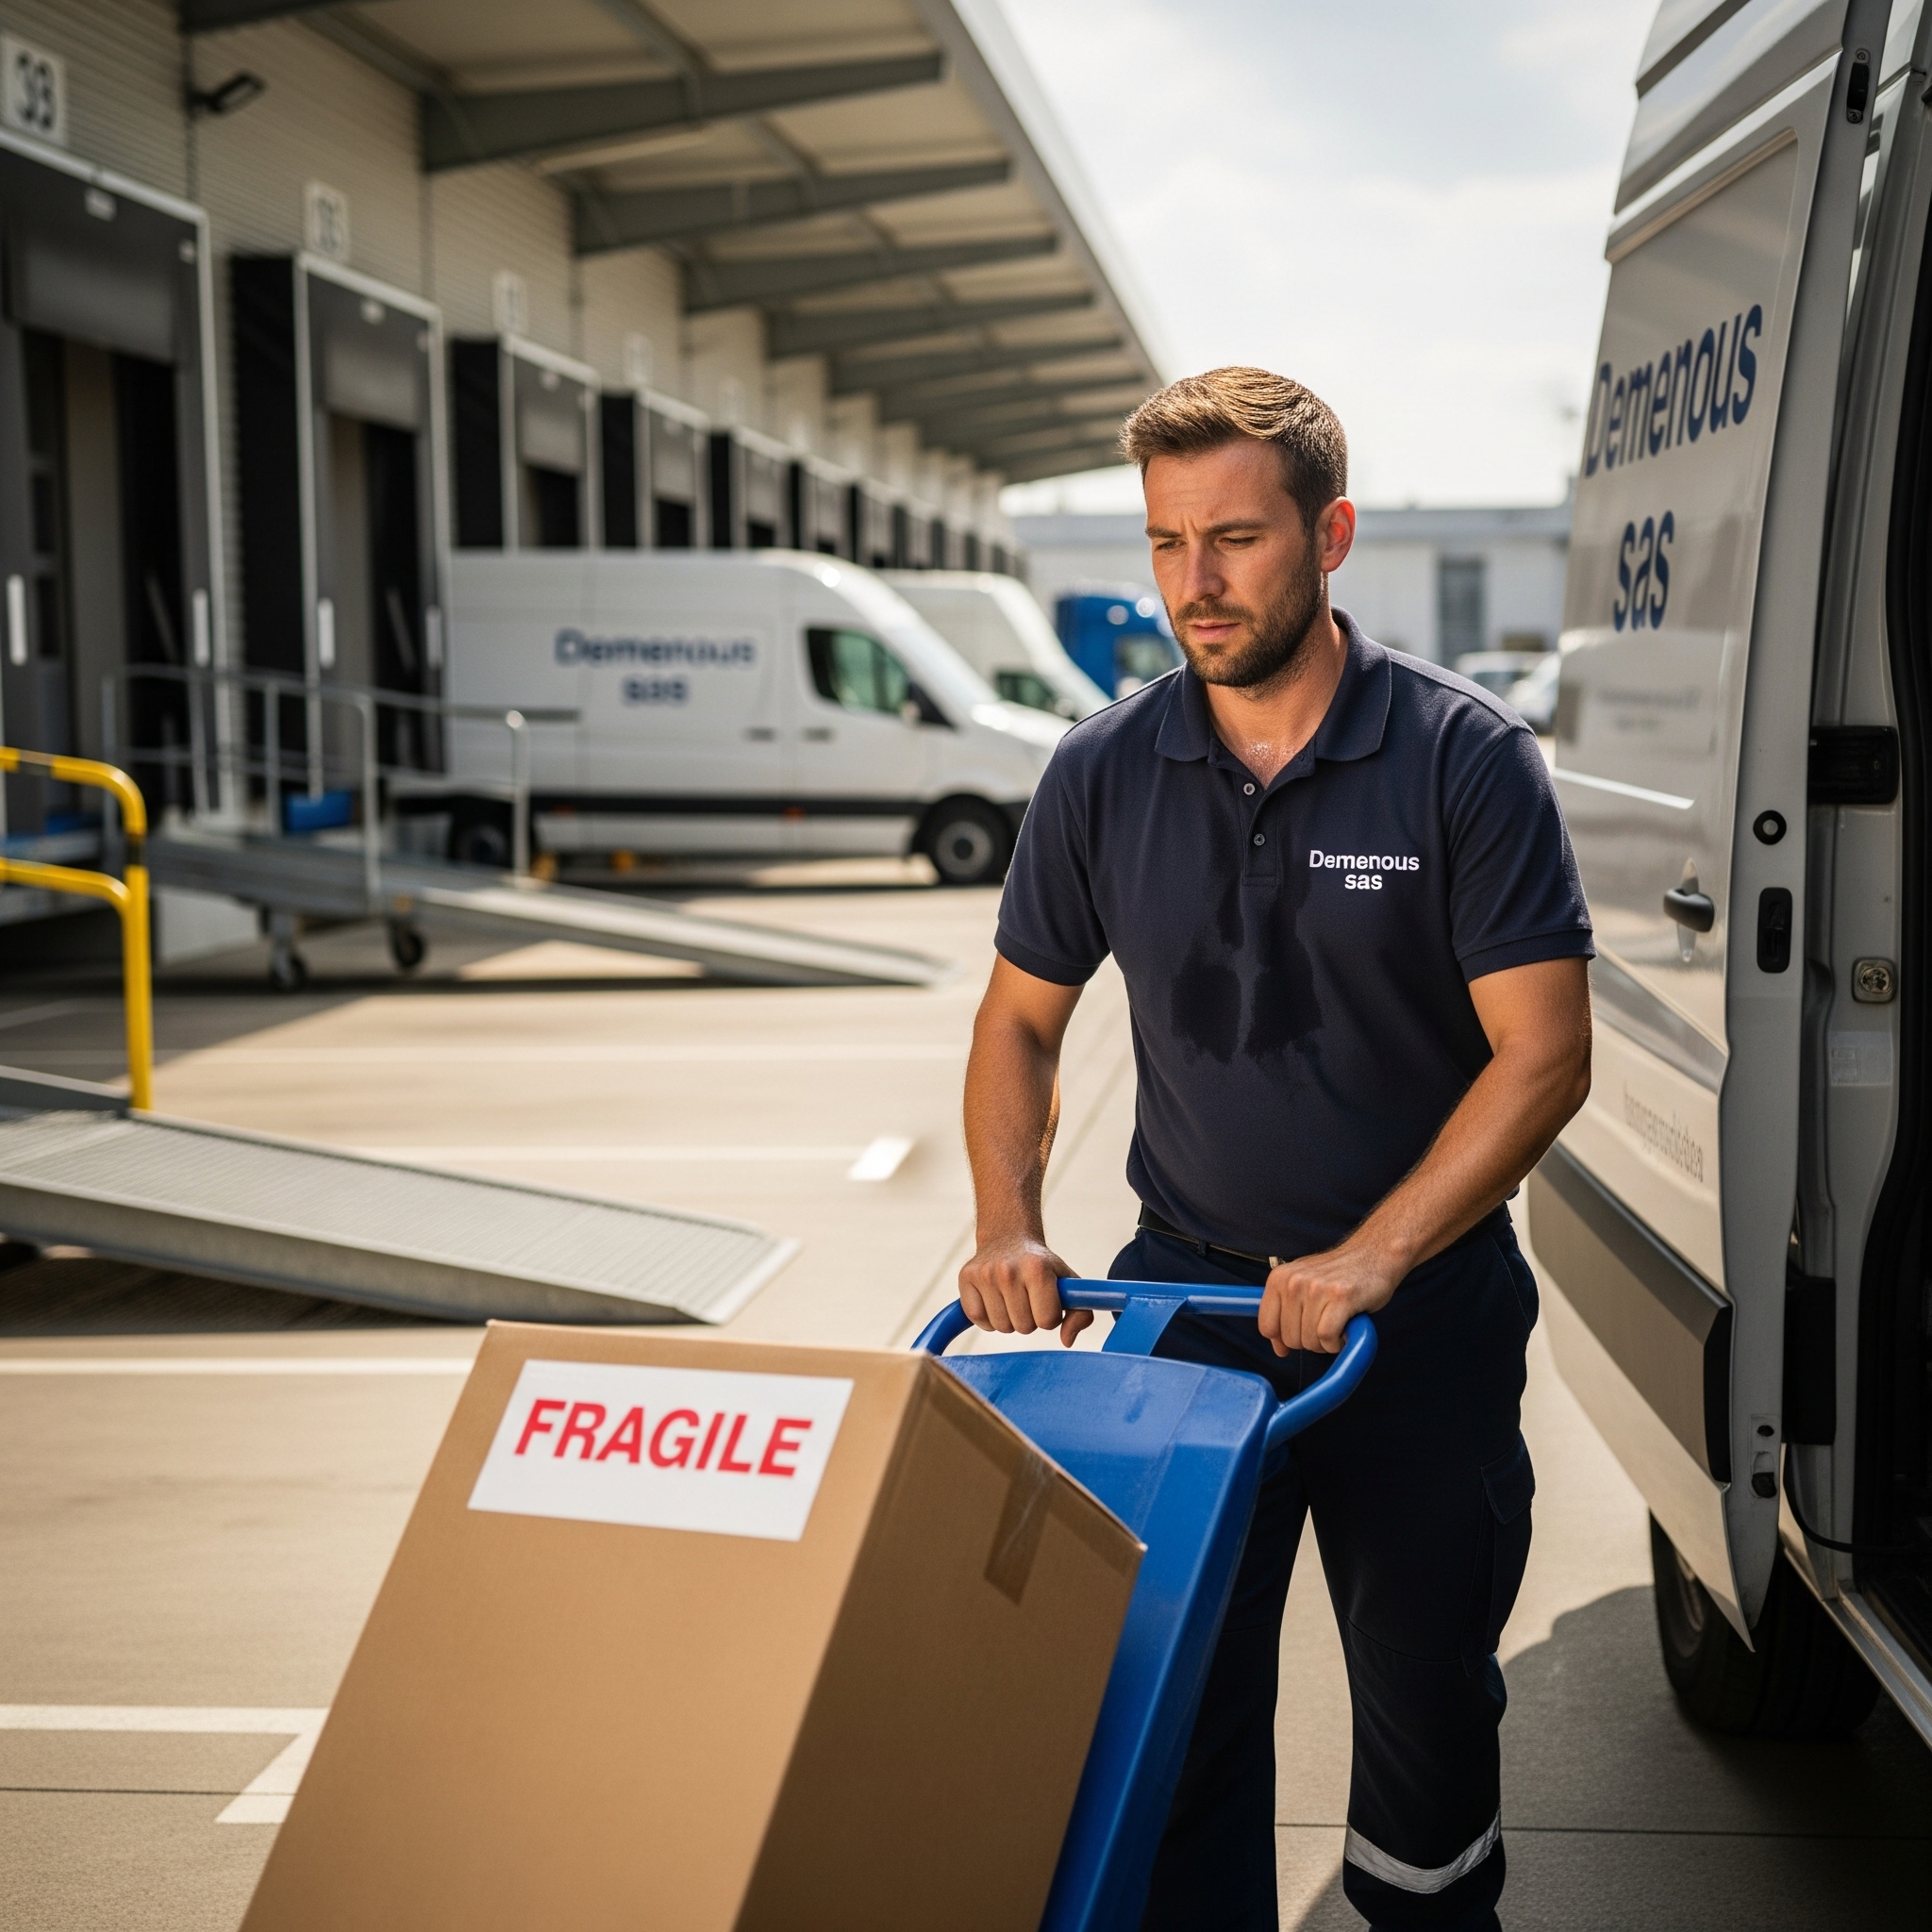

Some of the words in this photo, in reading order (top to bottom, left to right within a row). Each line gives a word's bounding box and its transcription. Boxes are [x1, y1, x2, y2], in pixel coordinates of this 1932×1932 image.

[1586, 304, 1763, 478] Demenous
[1613, 509, 1674, 633] sas
[1309, 849, 1420, 871] Demenous
[1344, 874, 1383, 891] sas
[514, 1398, 813, 1478] FRAGILE
